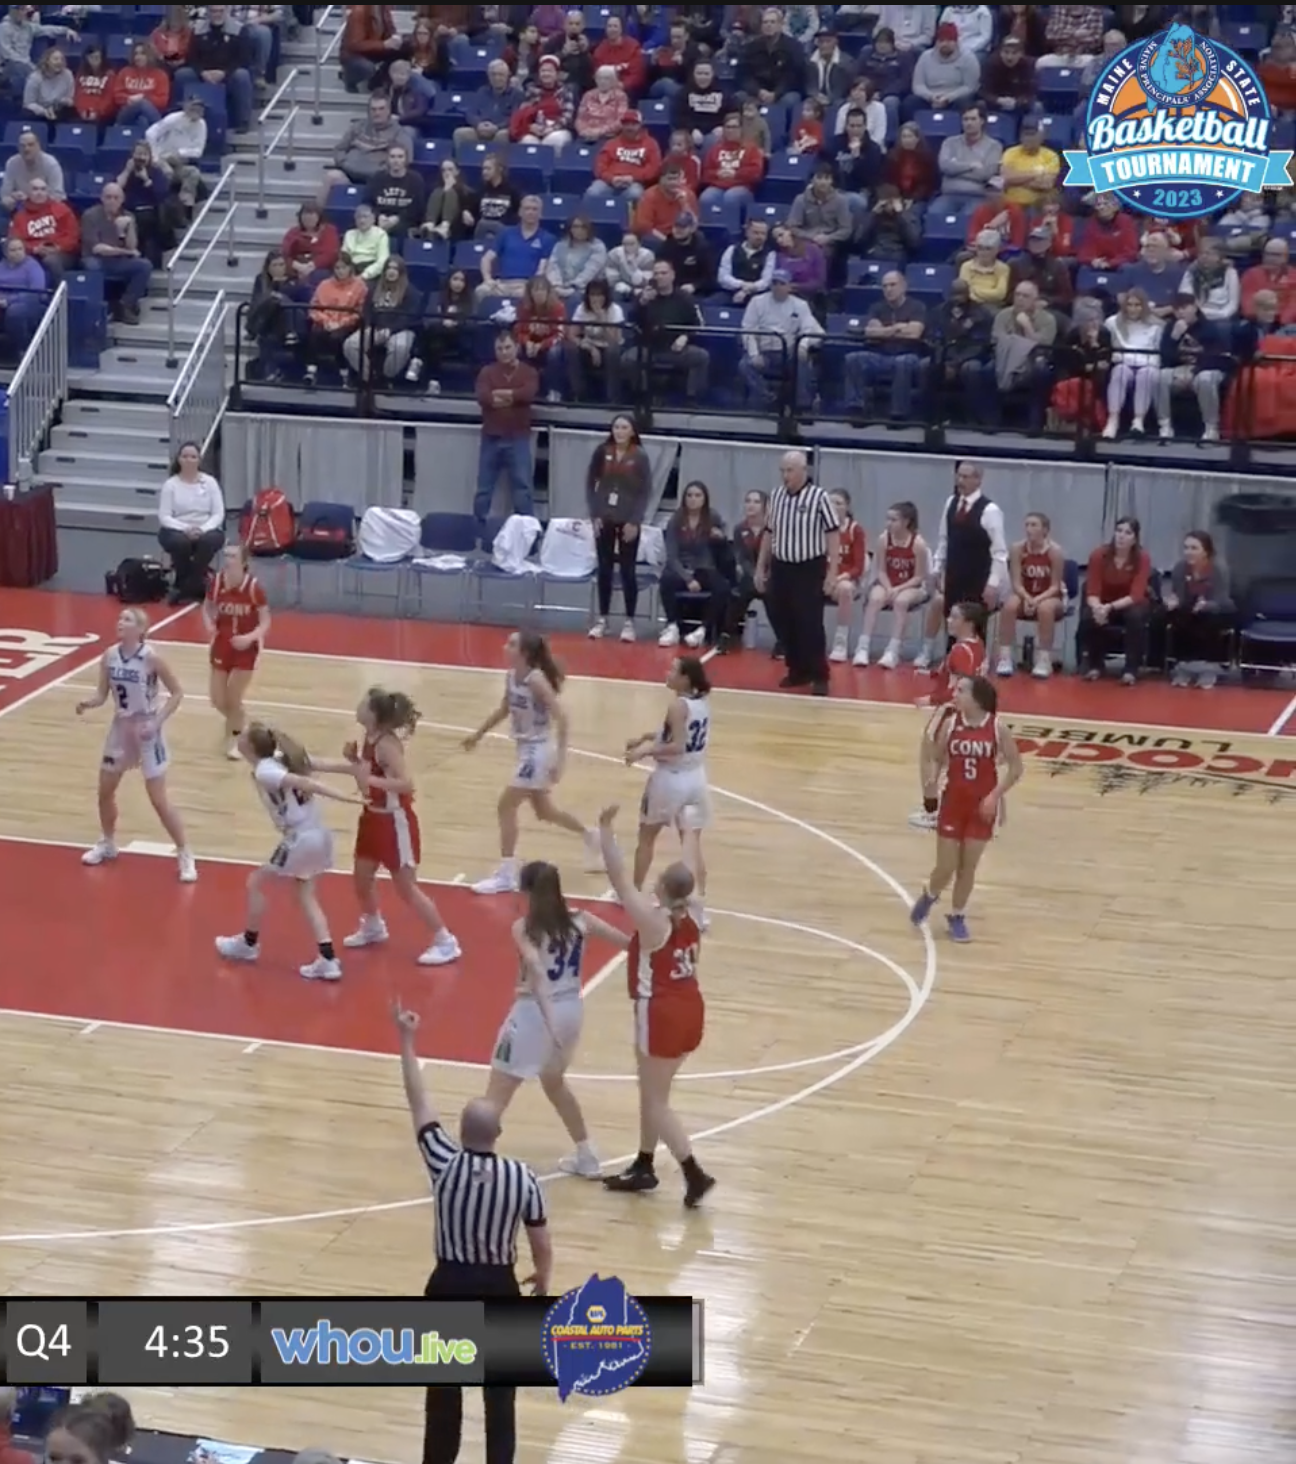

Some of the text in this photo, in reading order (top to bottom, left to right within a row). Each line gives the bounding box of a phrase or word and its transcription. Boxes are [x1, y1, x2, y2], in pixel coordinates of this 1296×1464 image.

[116, 684, 129, 709] 2
[950, 739, 992, 758] CONY
[1007, 723, 1233, 753] LUMBE
[964, 757, 978, 780] 5
[547, 932, 584, 982] 34
